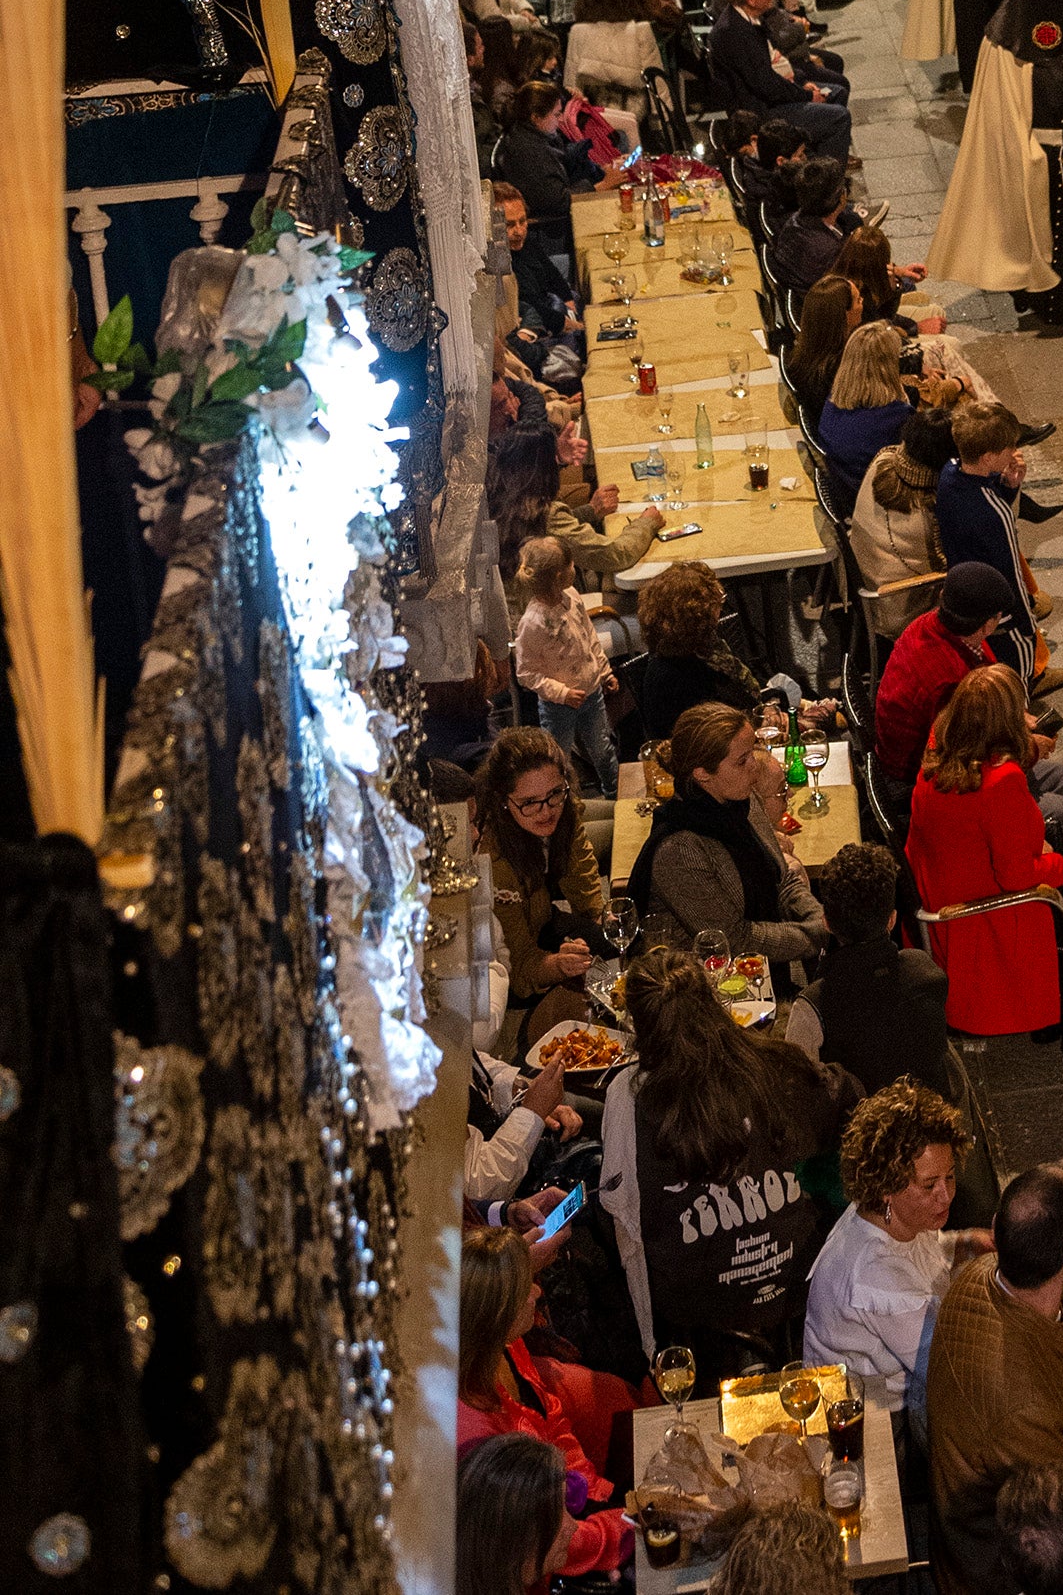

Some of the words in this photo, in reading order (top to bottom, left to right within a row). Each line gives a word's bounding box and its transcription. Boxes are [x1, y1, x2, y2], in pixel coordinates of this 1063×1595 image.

[731, 1240, 778, 1266] industry
[736, 1232, 770, 1254] fashion
[718, 1241, 793, 1285] management
